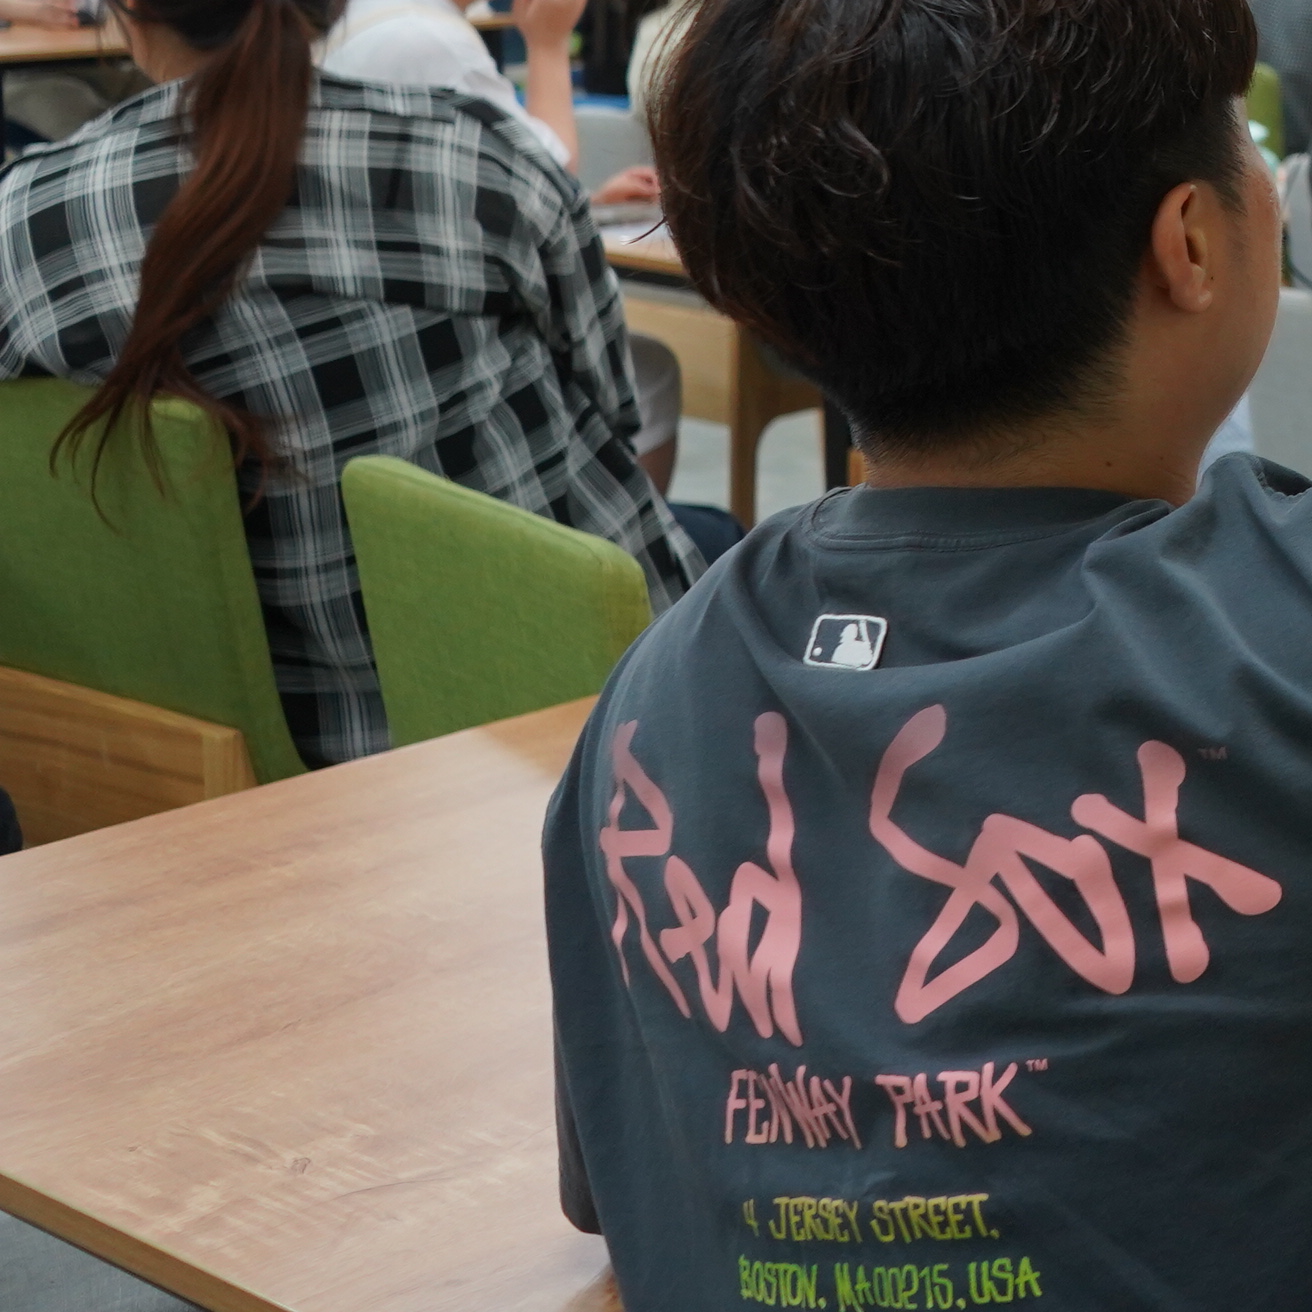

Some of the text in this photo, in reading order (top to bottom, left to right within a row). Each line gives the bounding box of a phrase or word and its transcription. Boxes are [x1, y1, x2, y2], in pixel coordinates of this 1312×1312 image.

[599, 710, 803, 1048] Red
[868, 703, 1283, 1024] Sox
[725, 1062, 863, 1150] FENWAY
[874, 1060, 1033, 1149] PARK
[743, 1198, 760, 1237] 4
[768, 1196, 863, 1243] JERSEY
[967, 1255, 1043, 1305] USA
